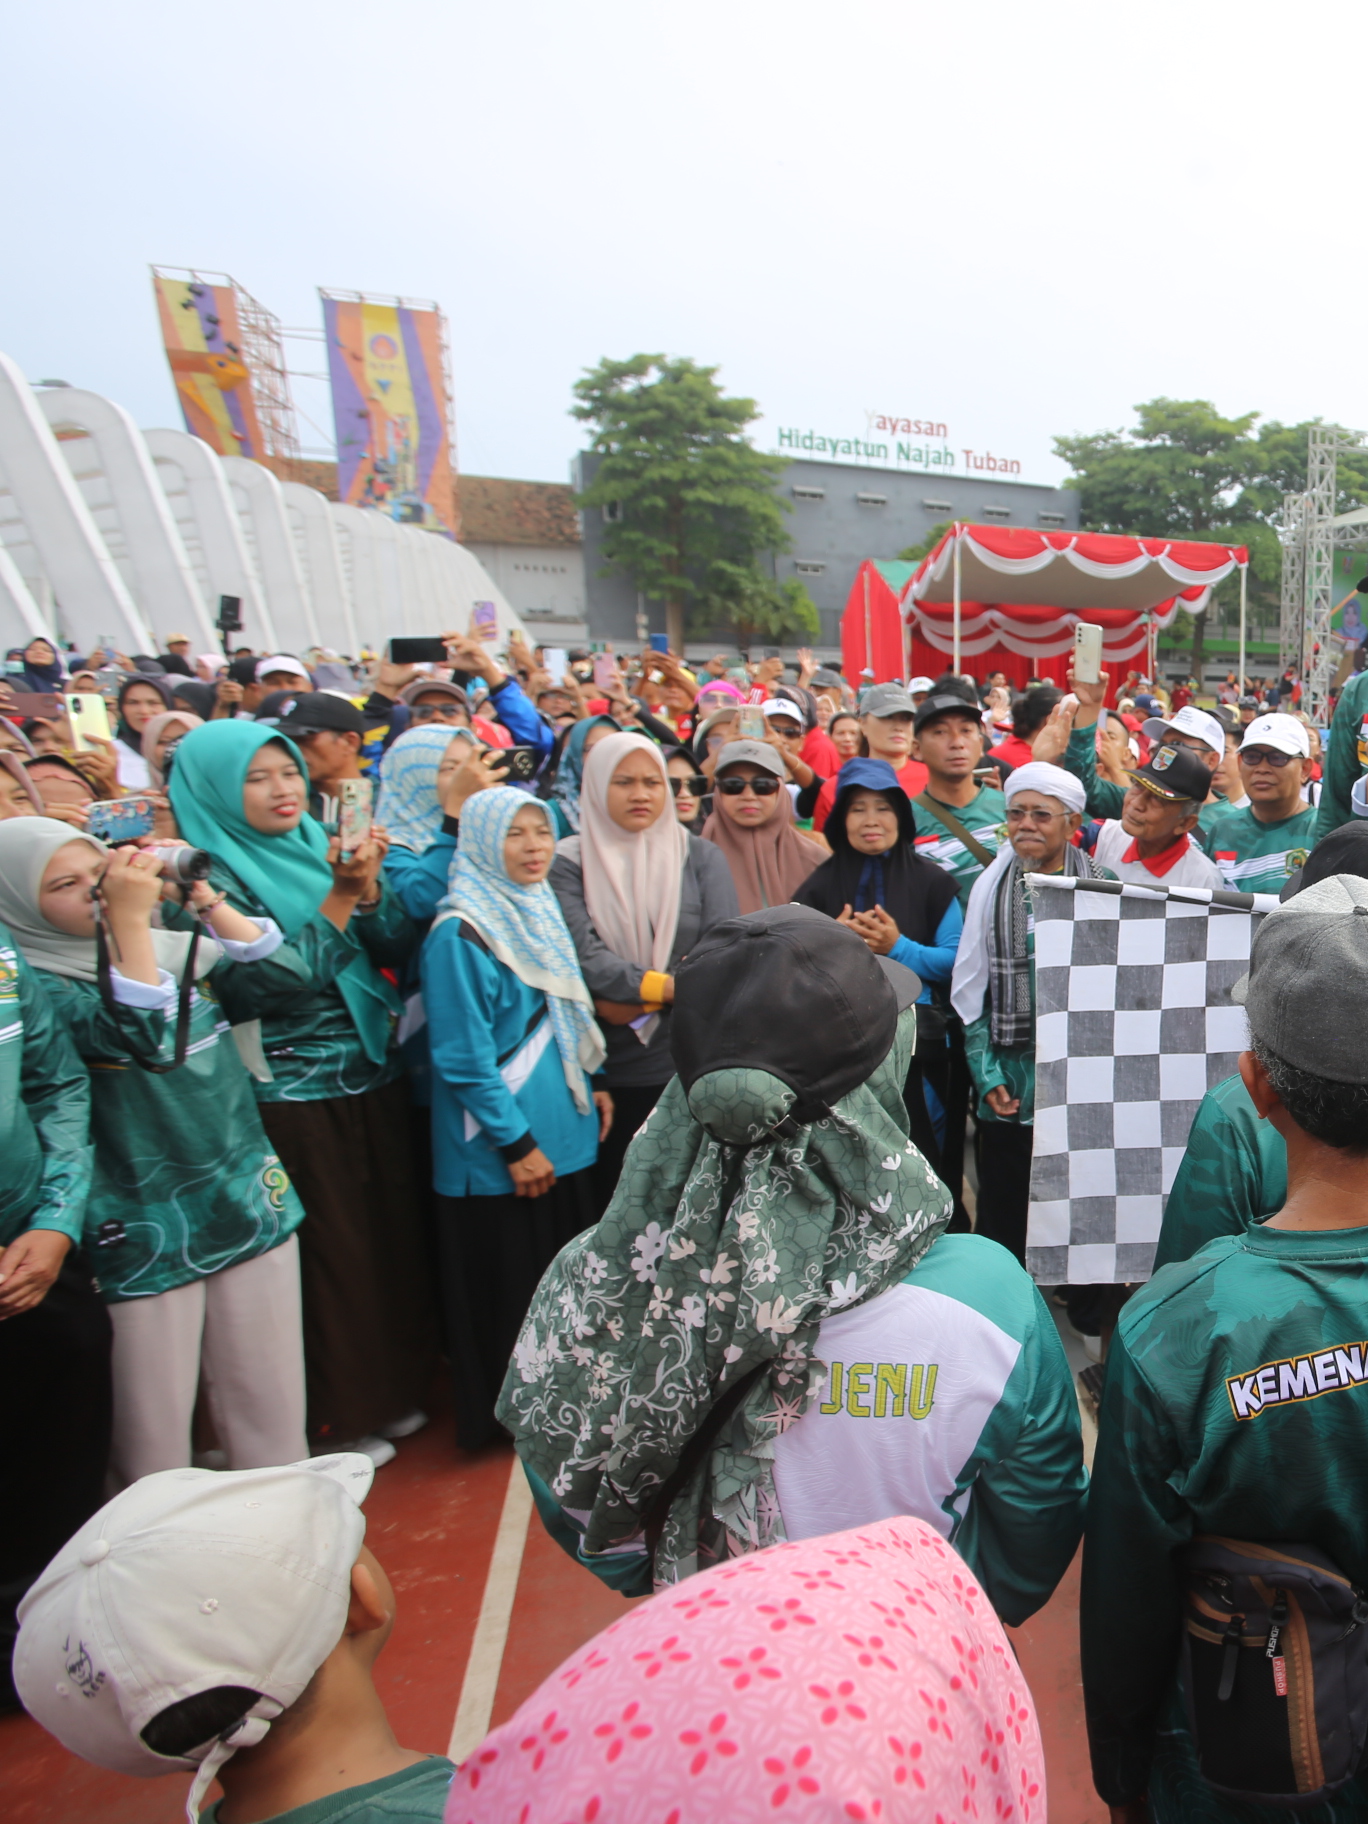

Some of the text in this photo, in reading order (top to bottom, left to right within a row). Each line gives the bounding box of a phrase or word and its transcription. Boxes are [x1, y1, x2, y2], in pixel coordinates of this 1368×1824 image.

[864, 409, 948, 437] Yayasan
[778, 426, 1020, 473] Hidayatun Najah Tuban
[820, 1361, 939, 1421] JENU
[1266, 1625, 1280, 1658] PUSHOP
[1274, 1660, 1285, 1695] PUSHOP
